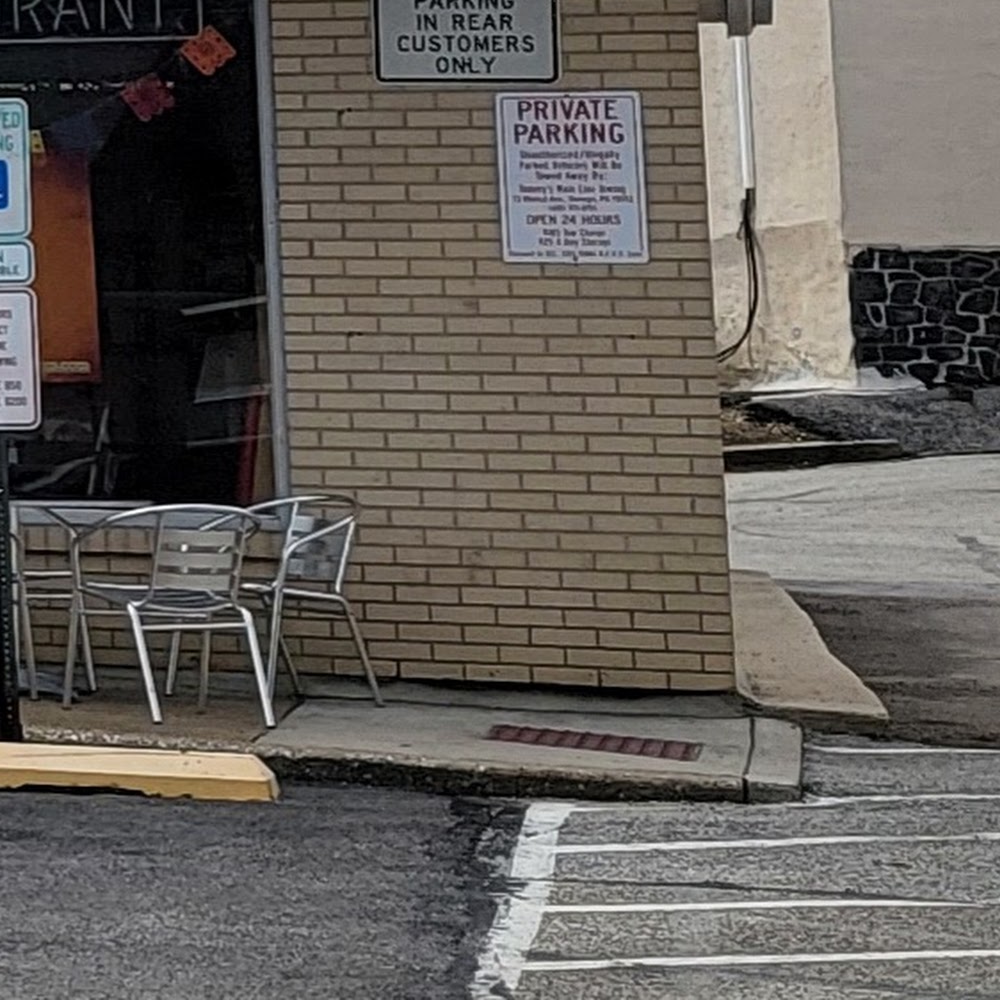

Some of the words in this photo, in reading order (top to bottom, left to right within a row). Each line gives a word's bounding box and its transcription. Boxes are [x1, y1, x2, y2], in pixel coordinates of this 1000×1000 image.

[417, 14, 437, 31] IN
[452, 14, 513, 31] REAR
[397, 35, 535, 52] CUSTOMERS
[436, 57, 496, 74] ONLY
[518, 100, 618, 121] PRIVATE
[514, 123, 624, 144] PARKING
[527, 215, 557, 225] OPEN
[562, 215, 577, 225] 24
[582, 215, 621, 225] HOURS
